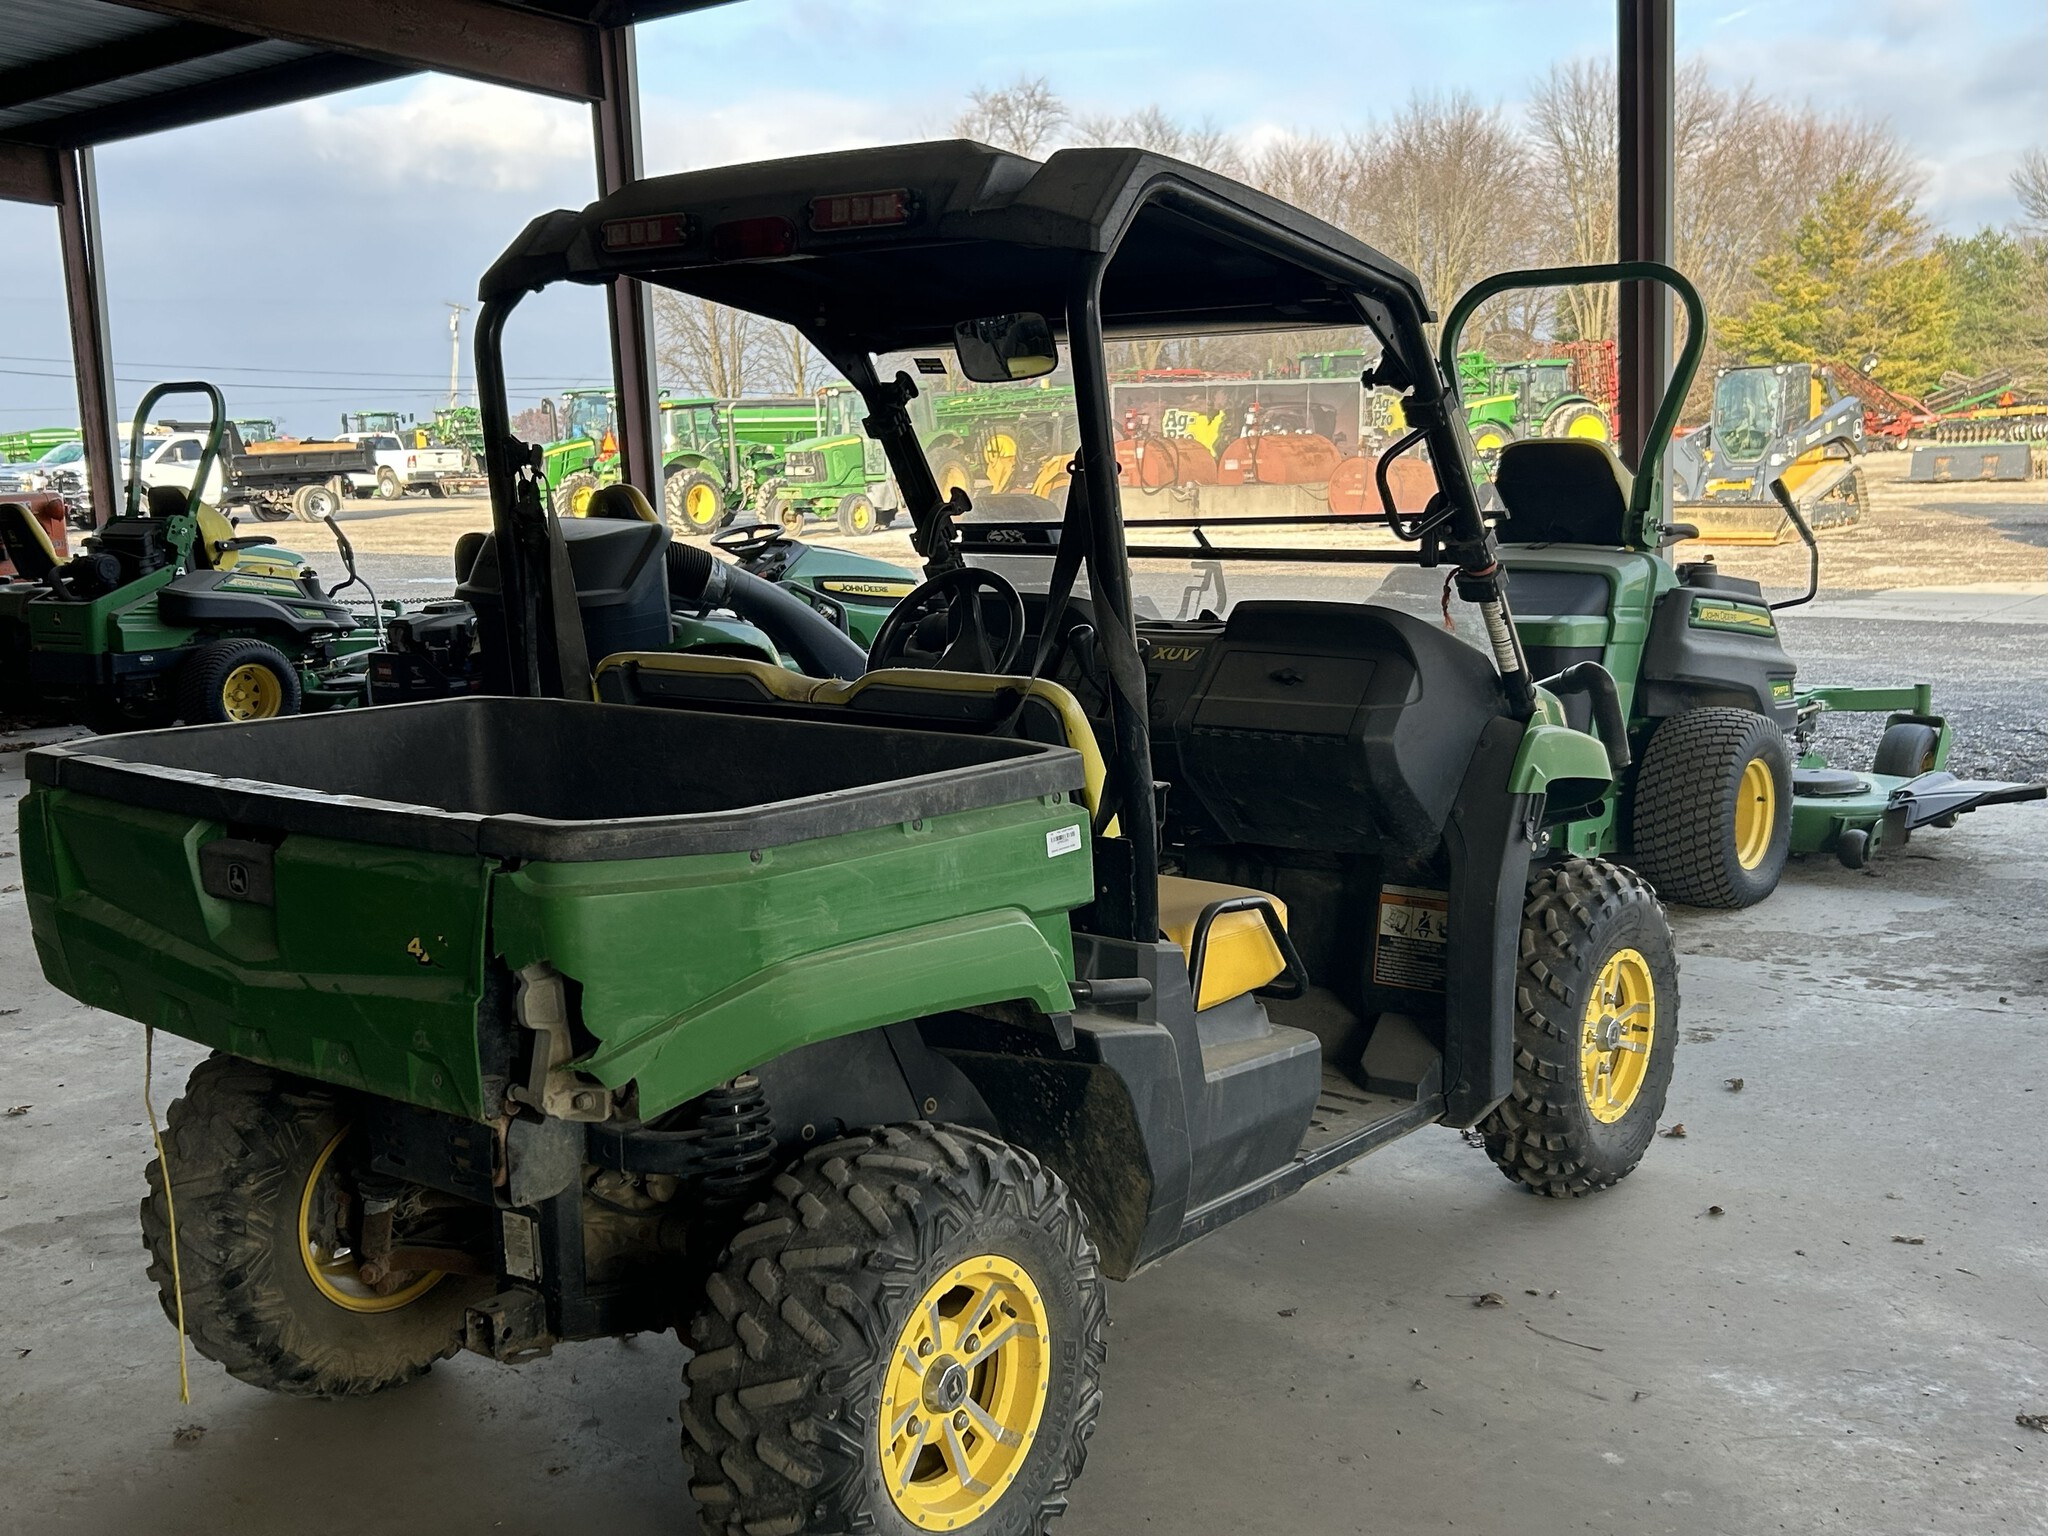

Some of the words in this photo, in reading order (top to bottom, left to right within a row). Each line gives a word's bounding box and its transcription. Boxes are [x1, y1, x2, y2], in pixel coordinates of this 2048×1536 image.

[1373, 411, 1393, 427] Pro
[840, 583, 863, 592] JOHN
[863, 584, 889, 593] DEERE
[1705, 610, 1720, 619] JOHN
[1720, 611, 1738, 621] DEERE
[1151, 647, 1200, 661] XUV
